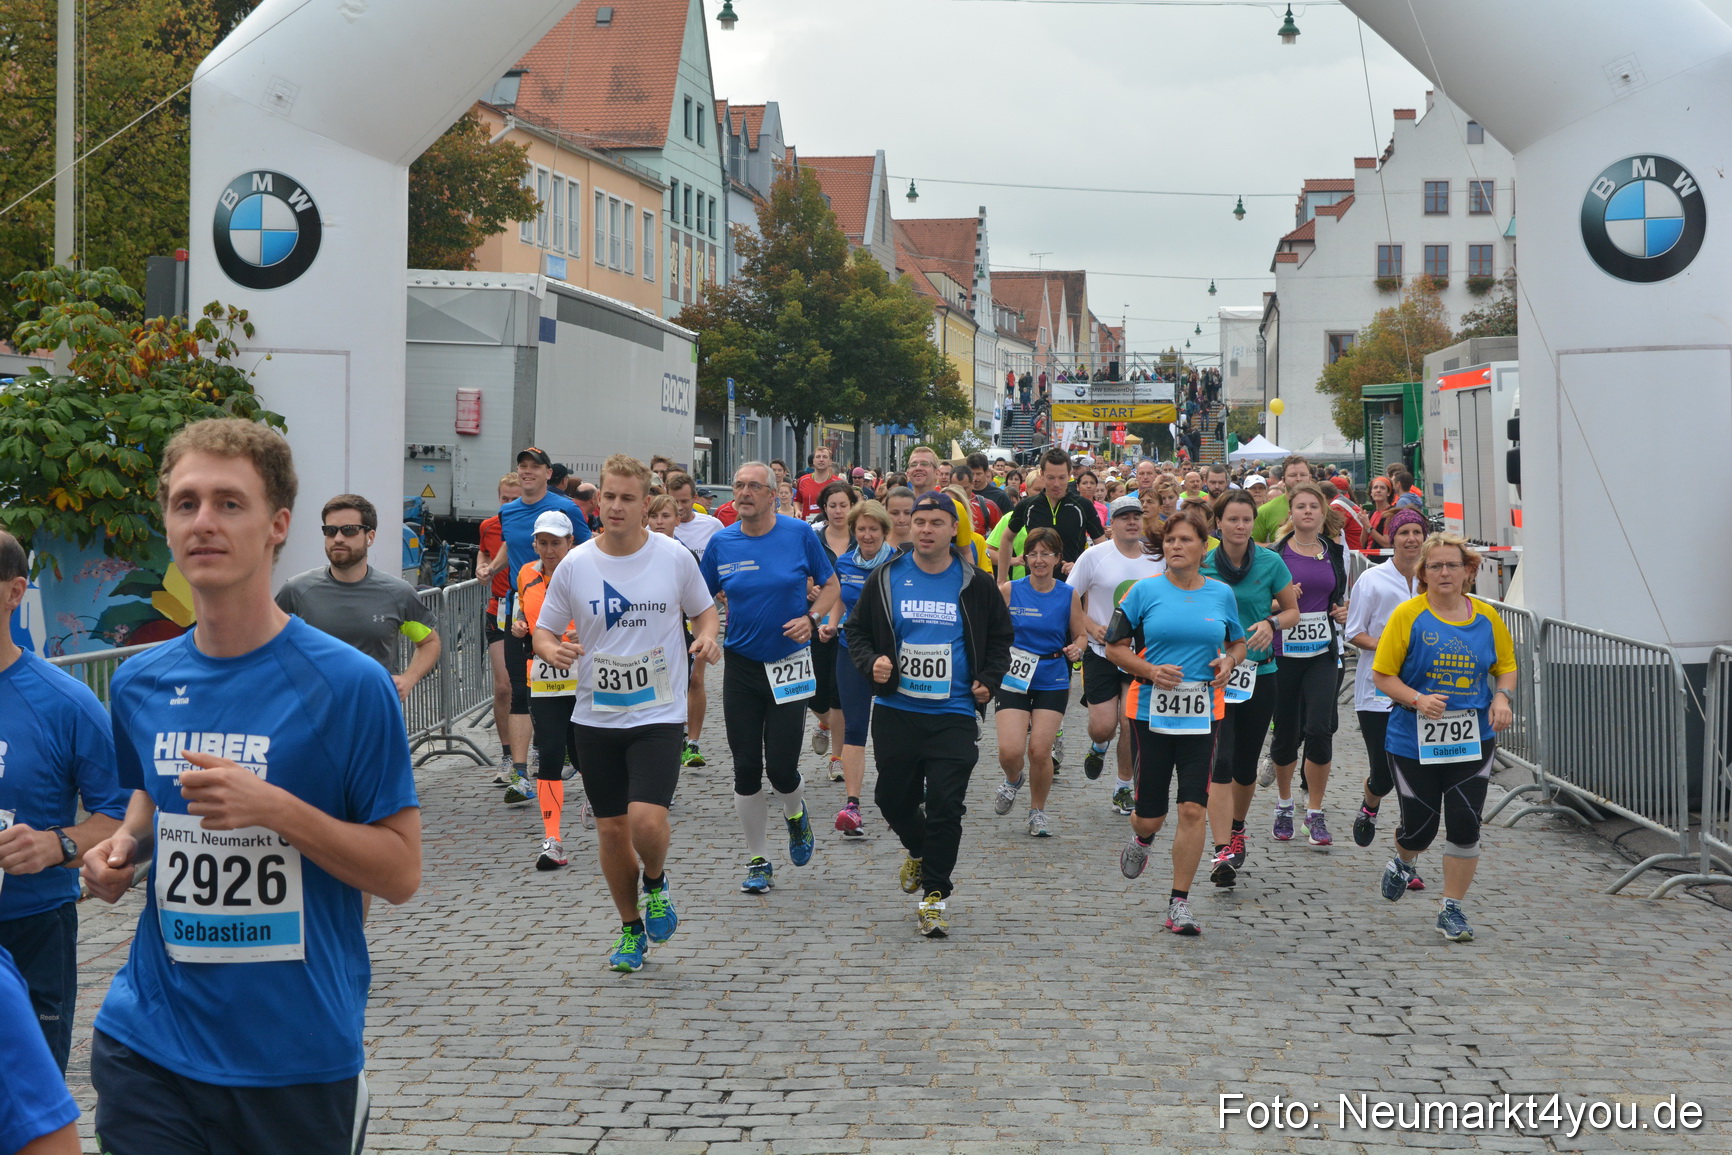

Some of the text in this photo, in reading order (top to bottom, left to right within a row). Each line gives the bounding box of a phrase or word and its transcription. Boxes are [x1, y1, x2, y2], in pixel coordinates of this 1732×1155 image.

[1591, 157, 1698, 201] BMW
[220, 173, 313, 213] BMW
[661, 372, 690, 416] BOCK
[1092, 407, 1136, 418] START
[901, 600, 957, 615] HUBER
[912, 612, 955, 621] TECHNOLOGY
[616, 617, 647, 628] Team
[1287, 622, 1327, 641] 2552
[593, 657, 641, 668] PARTL Neumarkt
[772, 659, 811, 685] 2274
[900, 655, 947, 679] 2860
[546, 682, 565, 692] Helga
[597, 666, 648, 691] 3310
[909, 681, 932, 692] Andre
[169, 697, 190, 706] erima
[1156, 693, 1205, 715] 3416
[1424, 719, 1474, 743] 2792
[153, 731, 271, 764] HUBER
[1433, 746, 1467, 756] Gabriele
[160, 827, 272, 847] PARTL Neumarkt
[166, 850, 287, 907] 2926
[174, 918, 271, 942] Sebastian
